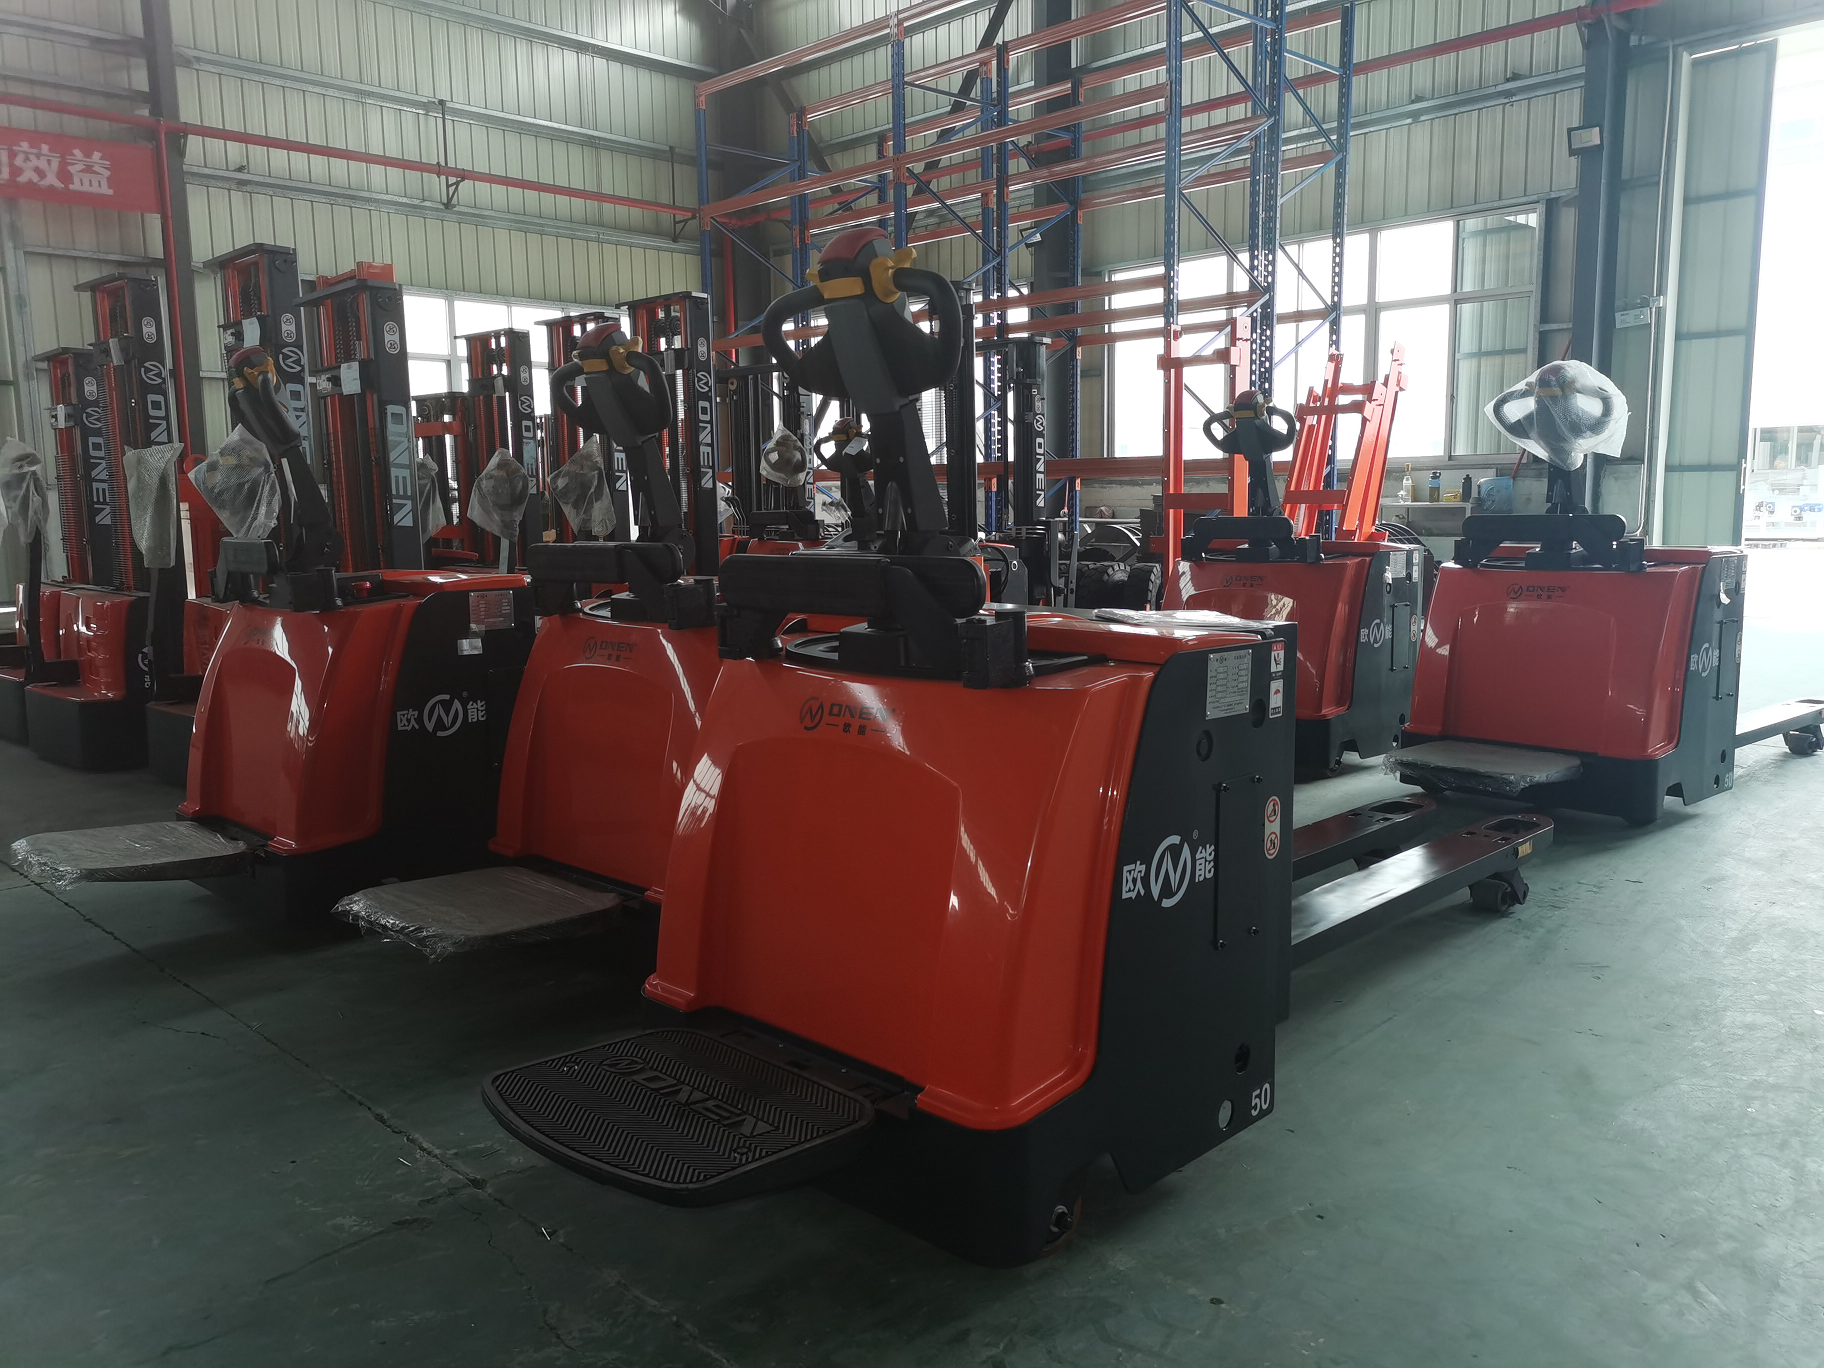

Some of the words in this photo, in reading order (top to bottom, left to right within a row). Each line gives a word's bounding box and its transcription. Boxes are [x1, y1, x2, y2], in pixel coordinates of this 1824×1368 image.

[0, 141, 113, 195] 效益
[147, 393, 169, 443] ON
[699, 401, 713, 488] ONEN
[386, 405, 413, 527] ONEN
[1035, 438, 1045, 507] ONEN
[828, 703, 888, 722] ONEN
[1122, 860, 1146, 900] 欧
[1195, 843, 1215, 883] 能
[1250, 1082, 1271, 1116] 50
